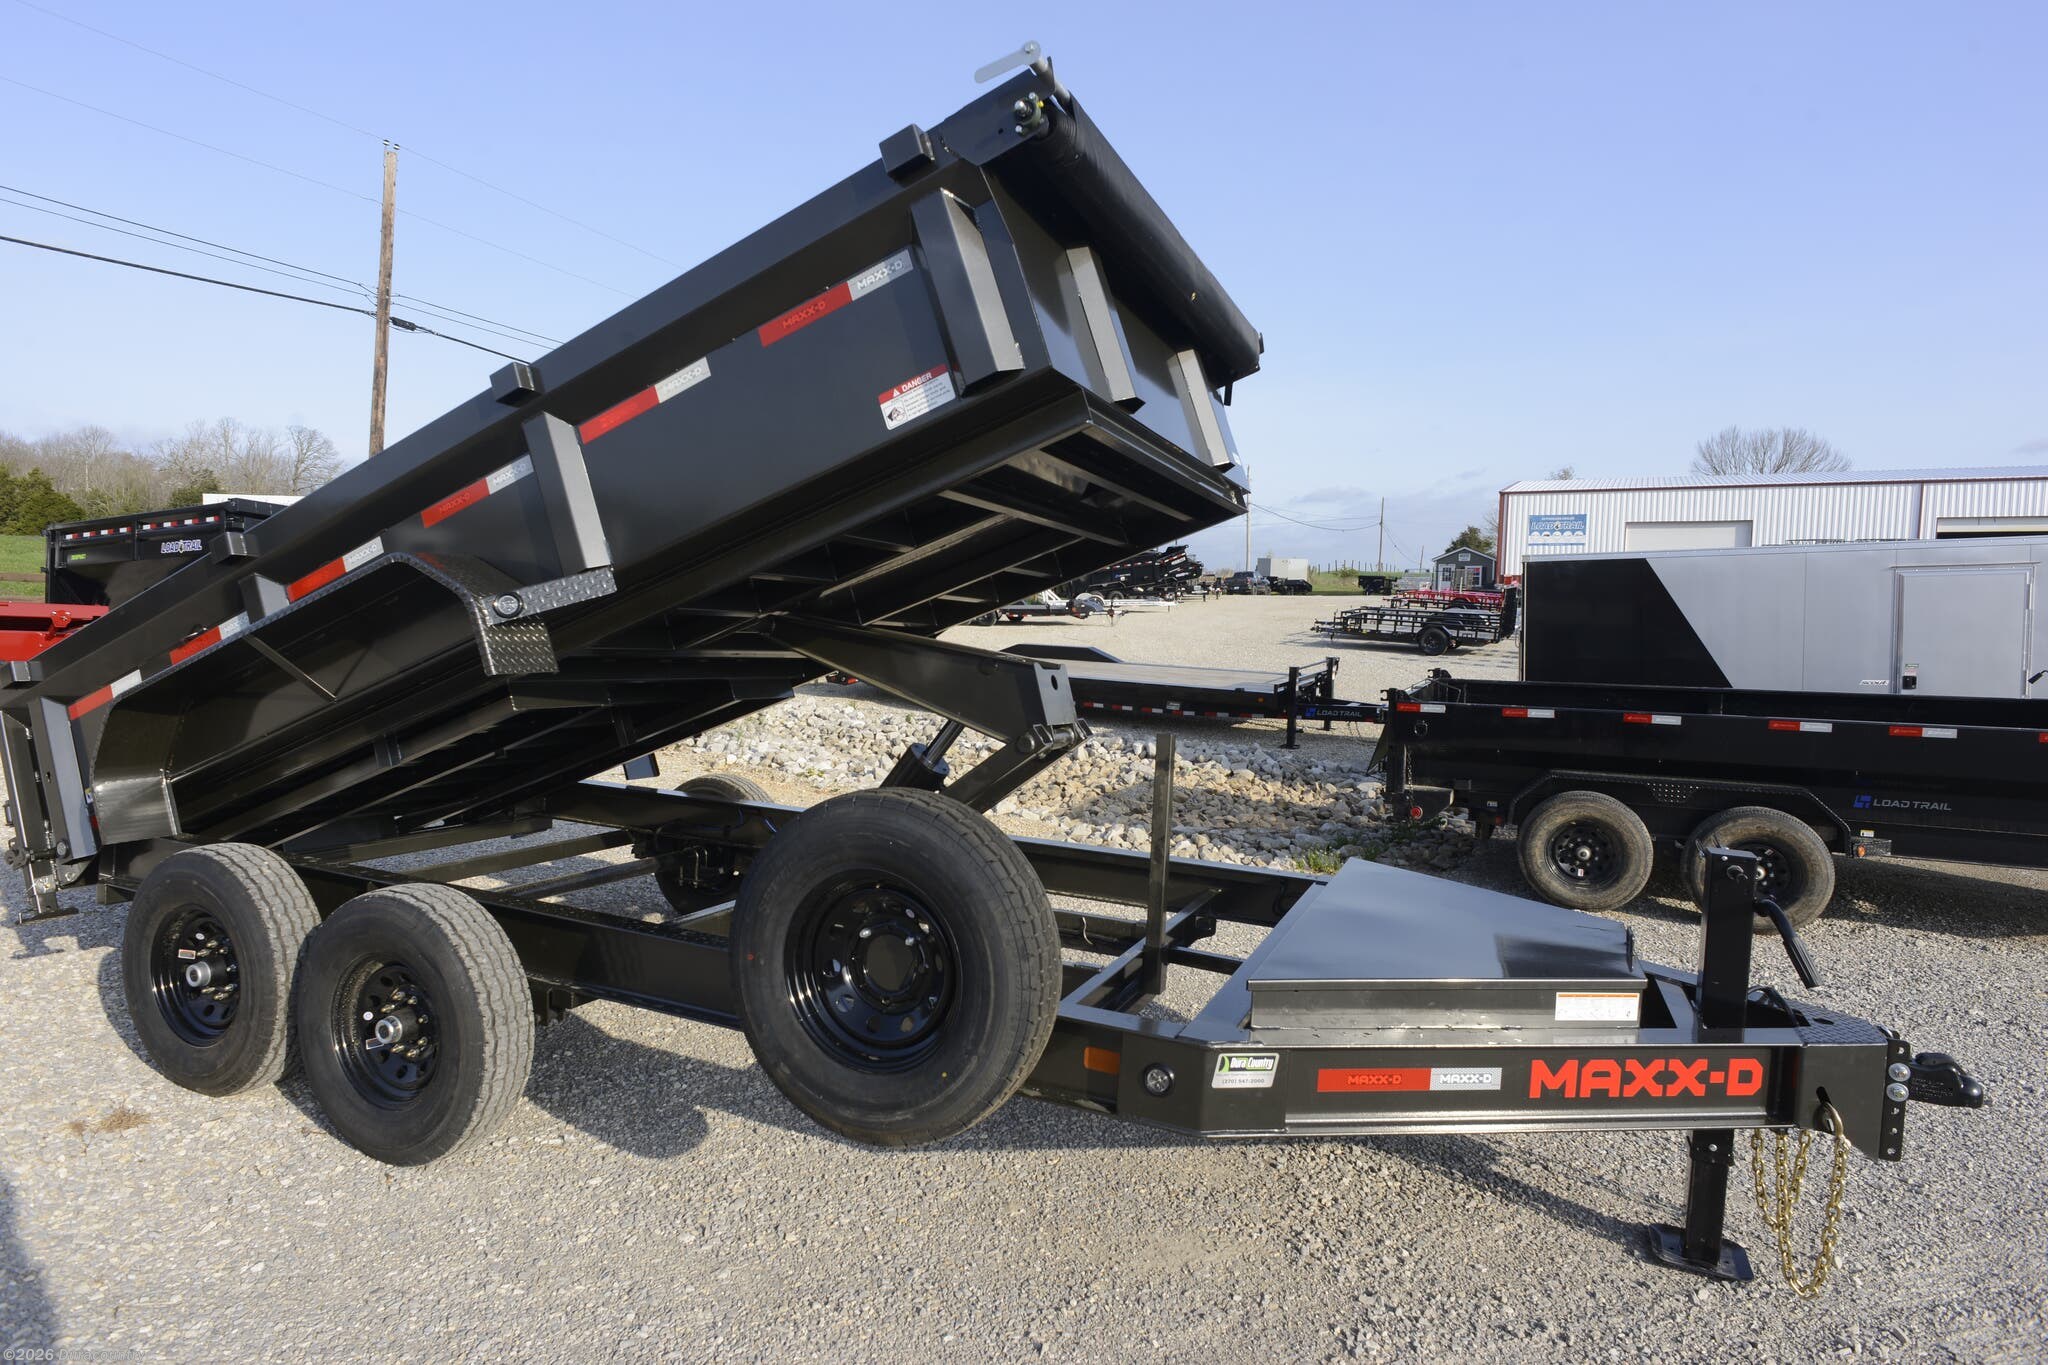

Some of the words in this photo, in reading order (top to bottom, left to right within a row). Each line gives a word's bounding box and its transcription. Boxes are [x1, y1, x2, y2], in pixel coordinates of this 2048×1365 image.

[856, 260, 903, 291] MAXX-D
[781, 301, 827, 329] MAXX-D
[902, 372, 933, 392] DANGER
[1316, 709, 1339, 717] LOAD
[1340, 710, 1362, 718] TRAIL
[1873, 798, 1911, 808] LOAD
[1912, 801, 1952, 811] TRAIL
[1230, 1056, 1247, 1069] Dura
[1247, 1056, 1274, 1070] Country
[1347, 1074, 1403, 1085] MAXX-D
[1439, 1072, 1493, 1084] MAXX-D
[1528, 1058, 1764, 1099] MAXX-D
